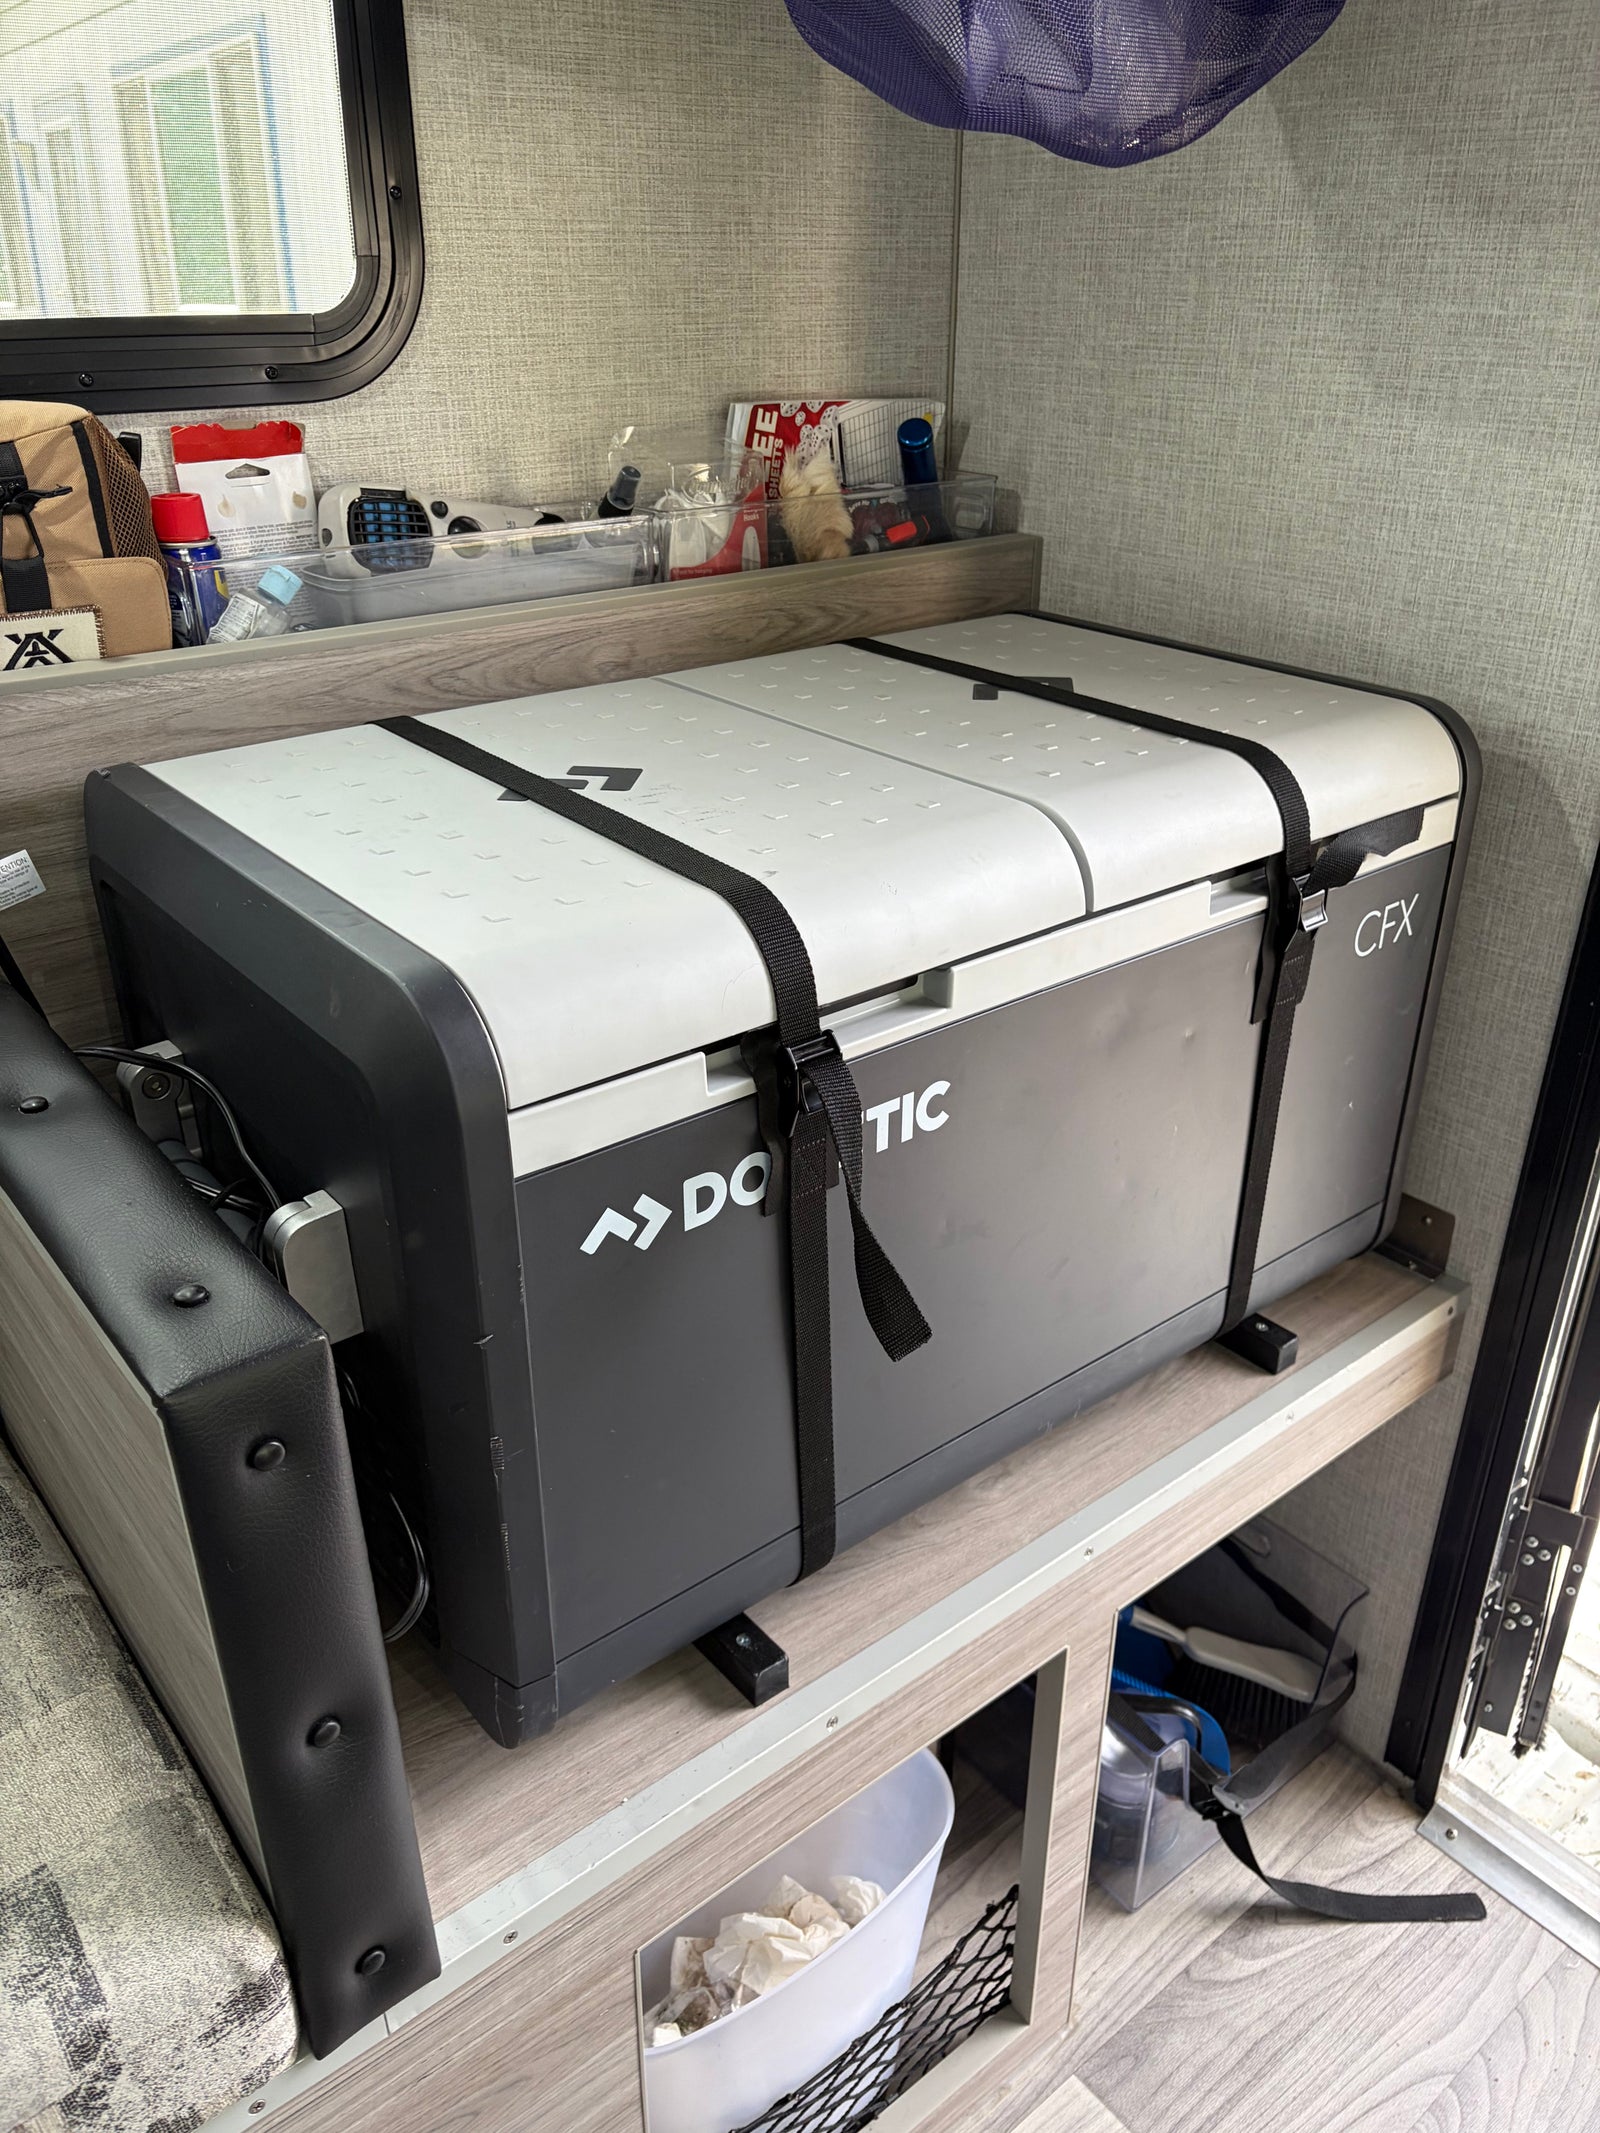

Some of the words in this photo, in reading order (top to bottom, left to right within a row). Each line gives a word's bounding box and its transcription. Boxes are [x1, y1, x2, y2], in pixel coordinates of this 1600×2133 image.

[752, 408, 779, 482] EE
[769, 438, 784, 498] SHEETS
[0, 856, 28, 874] ENTION
[1354, 893, 1420, 957] CFX
[683, 1080, 951, 1232] DOTIC
